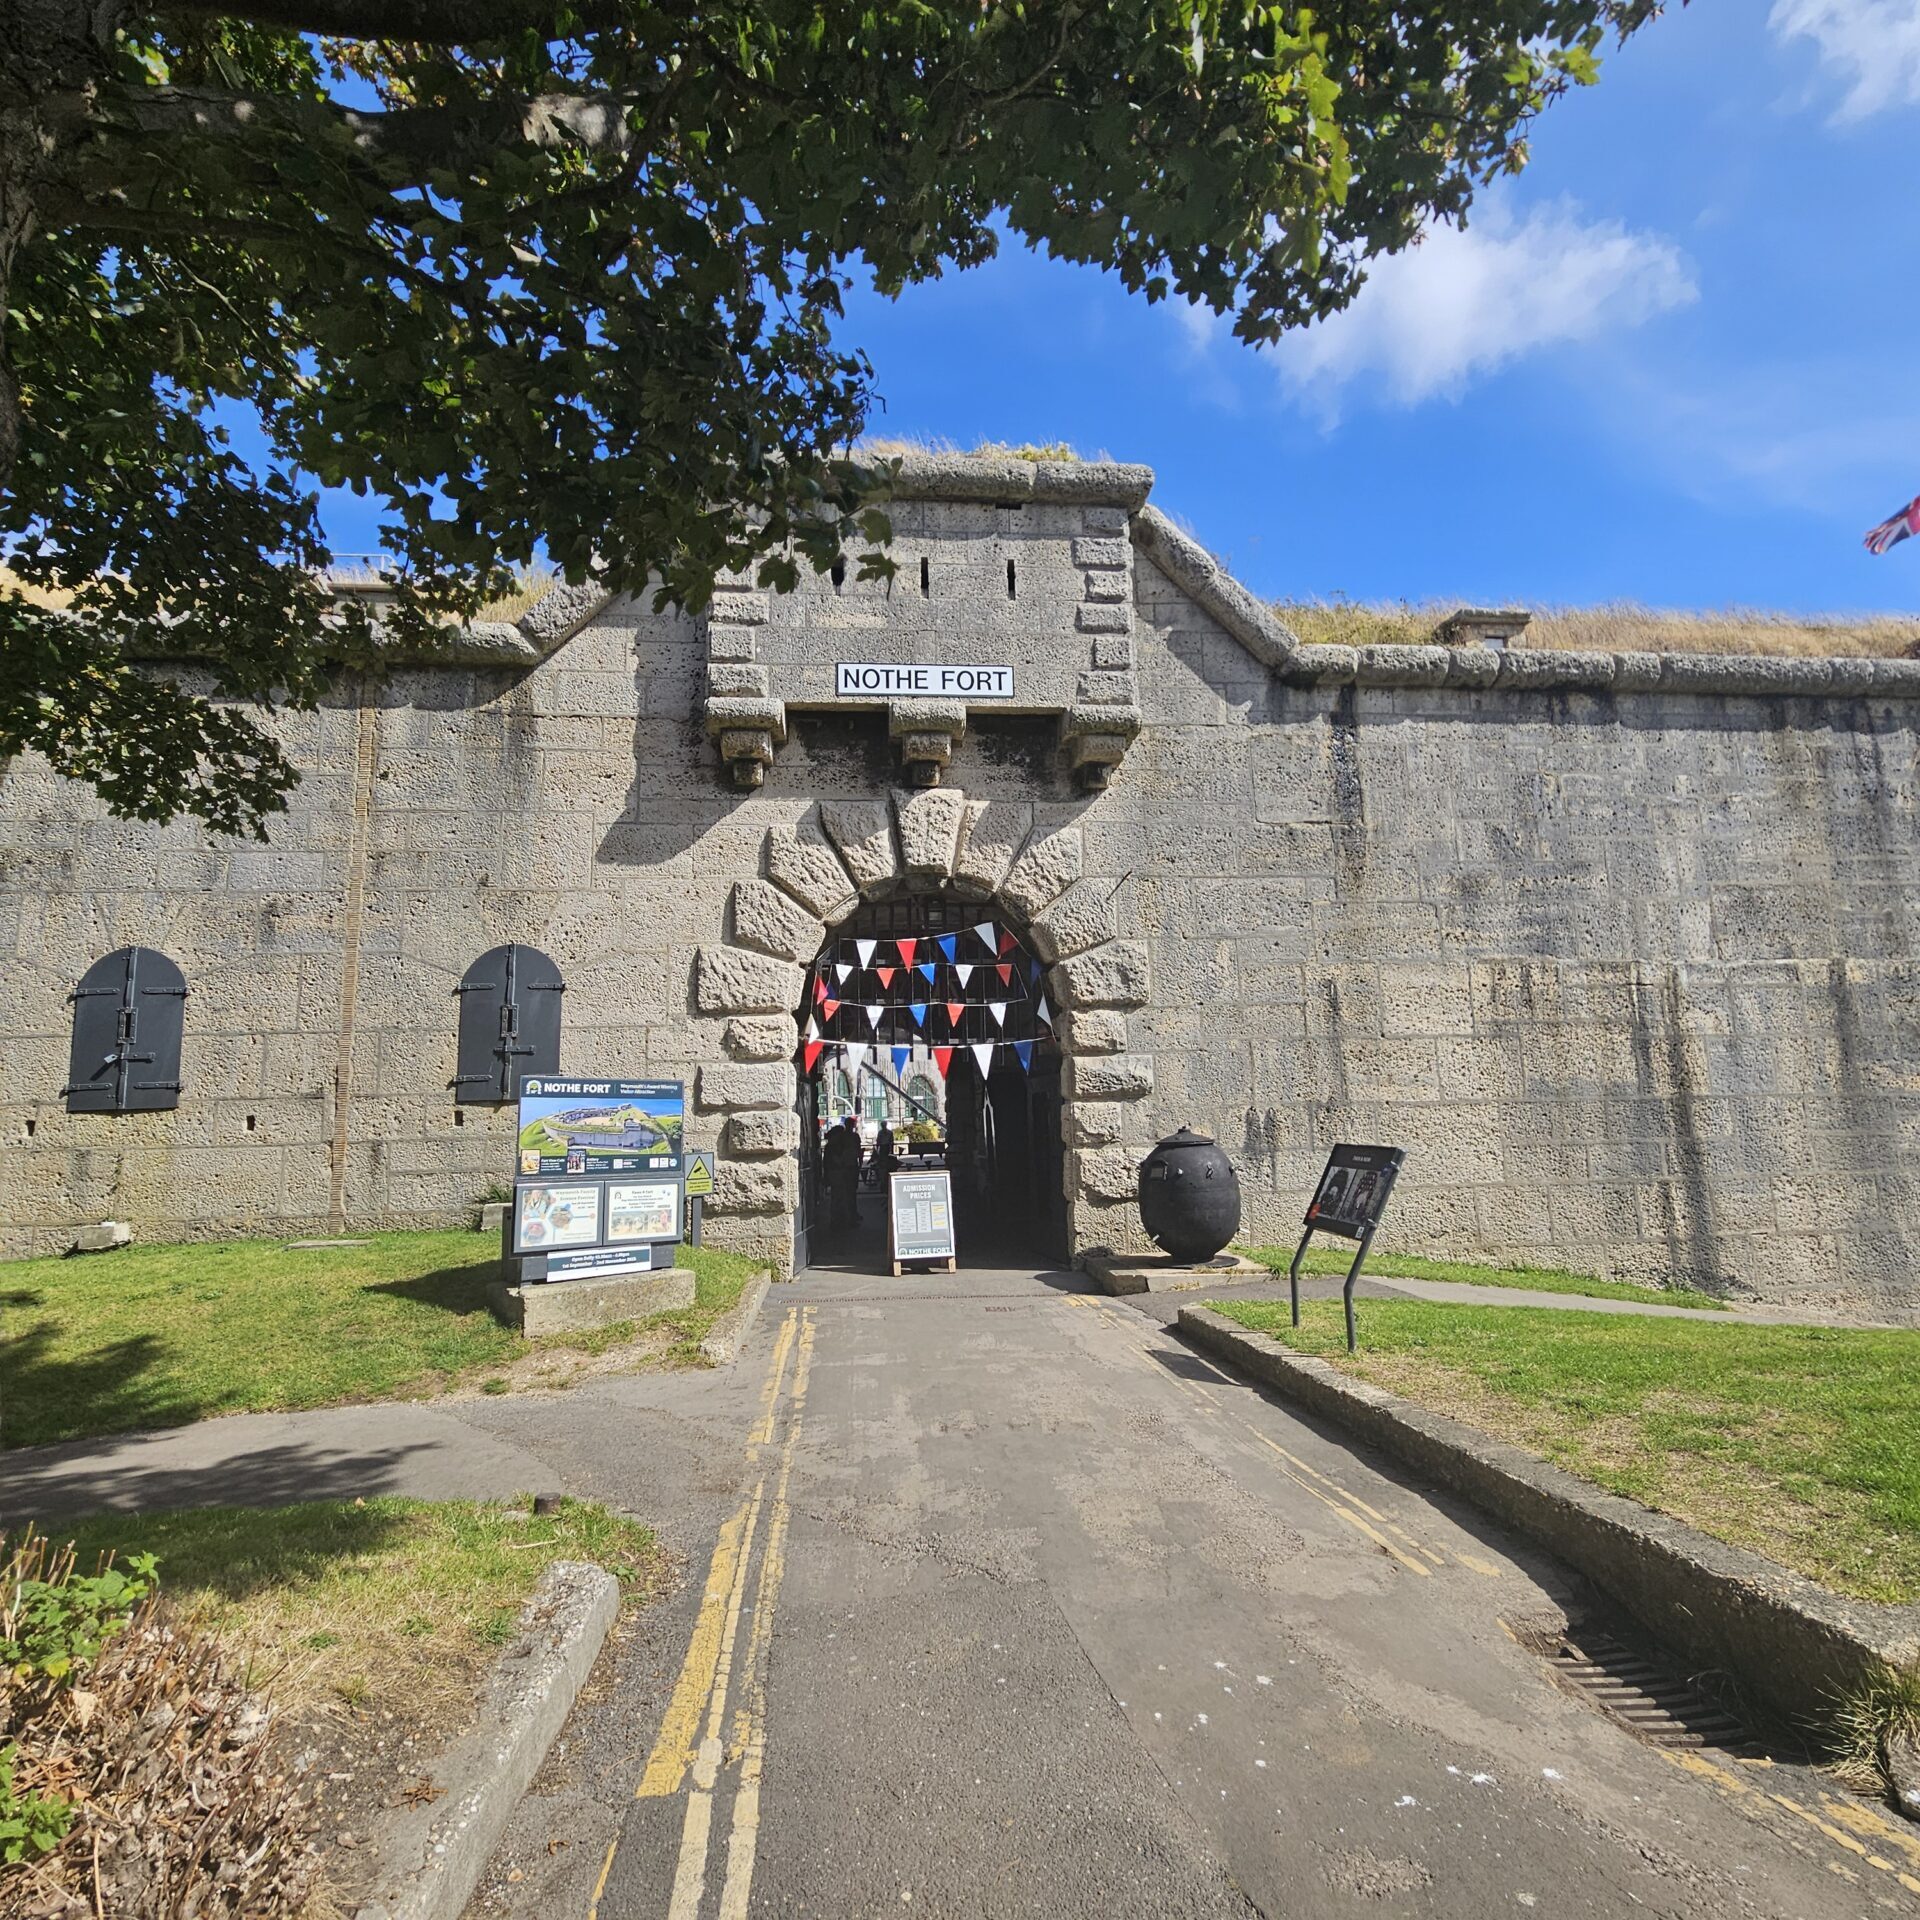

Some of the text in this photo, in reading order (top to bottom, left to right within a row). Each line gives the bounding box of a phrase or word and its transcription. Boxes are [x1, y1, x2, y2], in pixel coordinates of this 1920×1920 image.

[844, 668, 1008, 691] NOTHE FORT
[544, 1082, 611, 1094] NOTHE FORT
[902, 1184, 936, 1193] ADMISSION
[909, 1191, 932, 1200] PRICES
[908, 1248, 932, 1256] NOTHE
